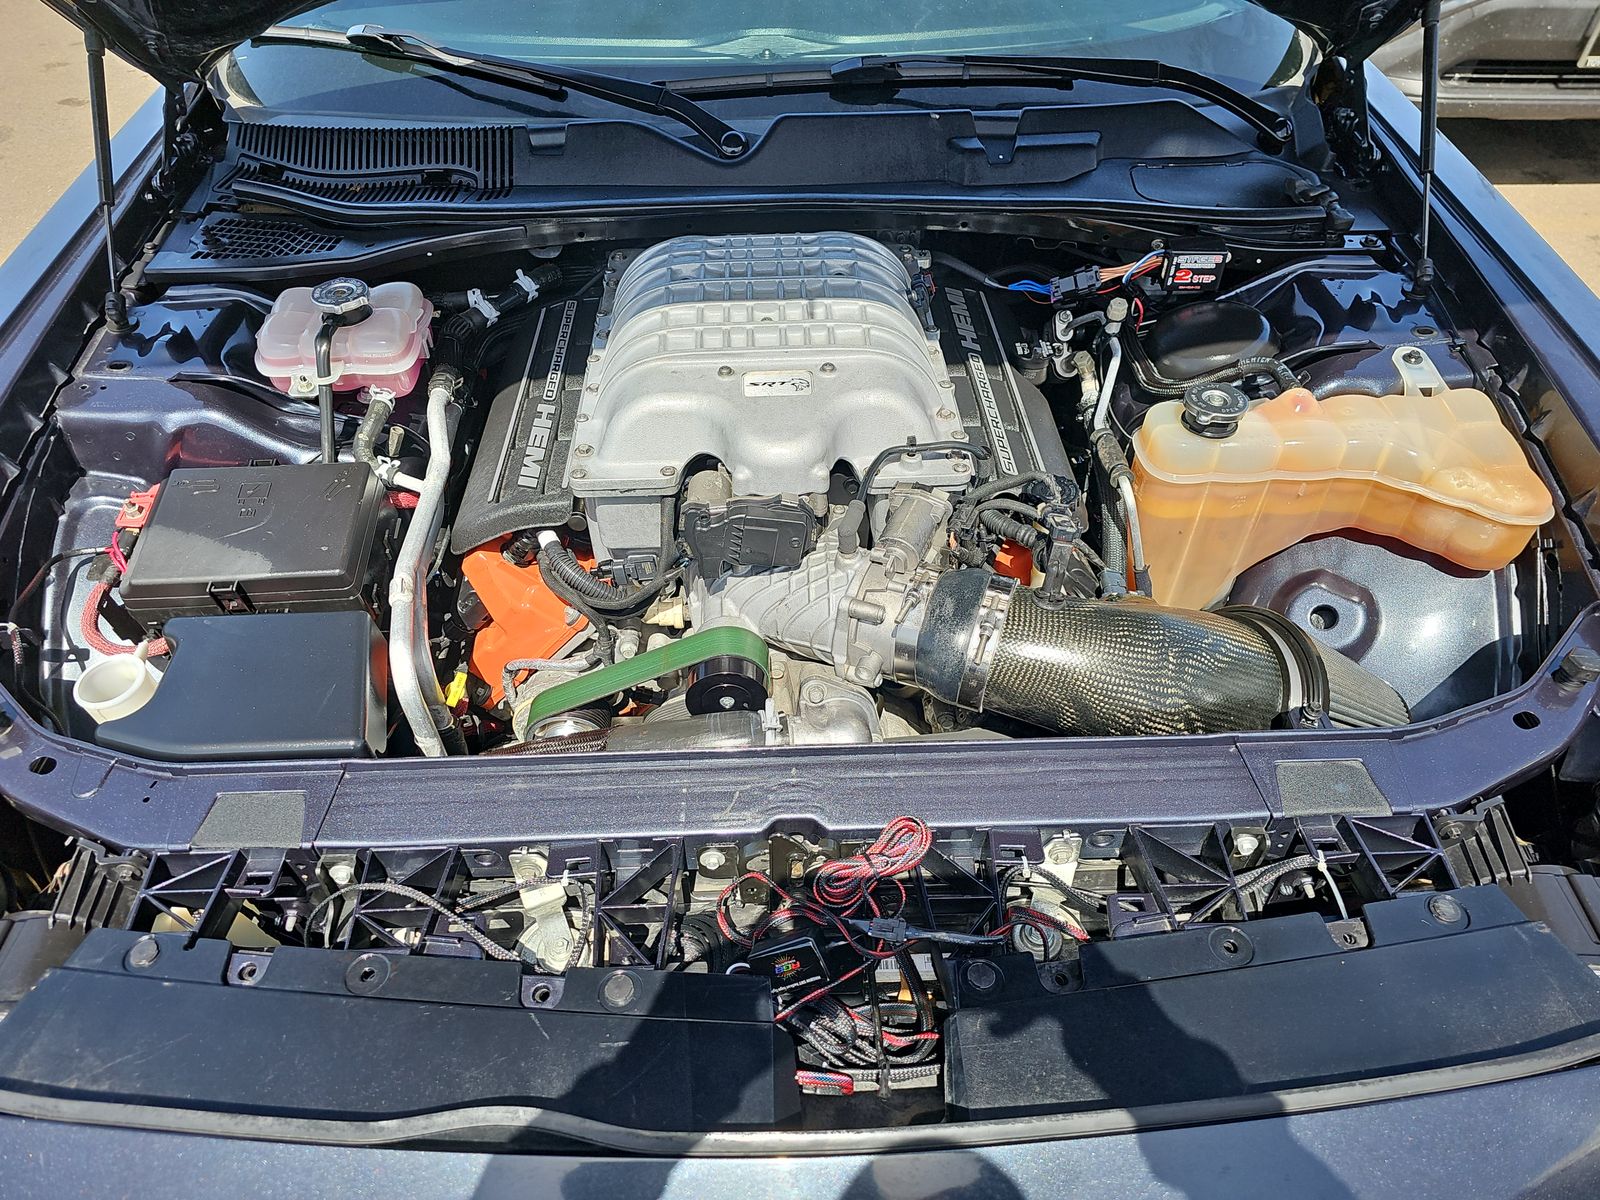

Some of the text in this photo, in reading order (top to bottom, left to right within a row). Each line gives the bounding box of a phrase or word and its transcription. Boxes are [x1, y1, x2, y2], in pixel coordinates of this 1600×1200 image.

[1173, 268, 1216, 283] 2 STEP
[543, 300, 577, 401] SUPERCHARGED
[746, 380, 791, 389] SRT
[944, 287, 1019, 476] SUPERCHARGED HEMI
[517, 403, 556, 489] HEMI
